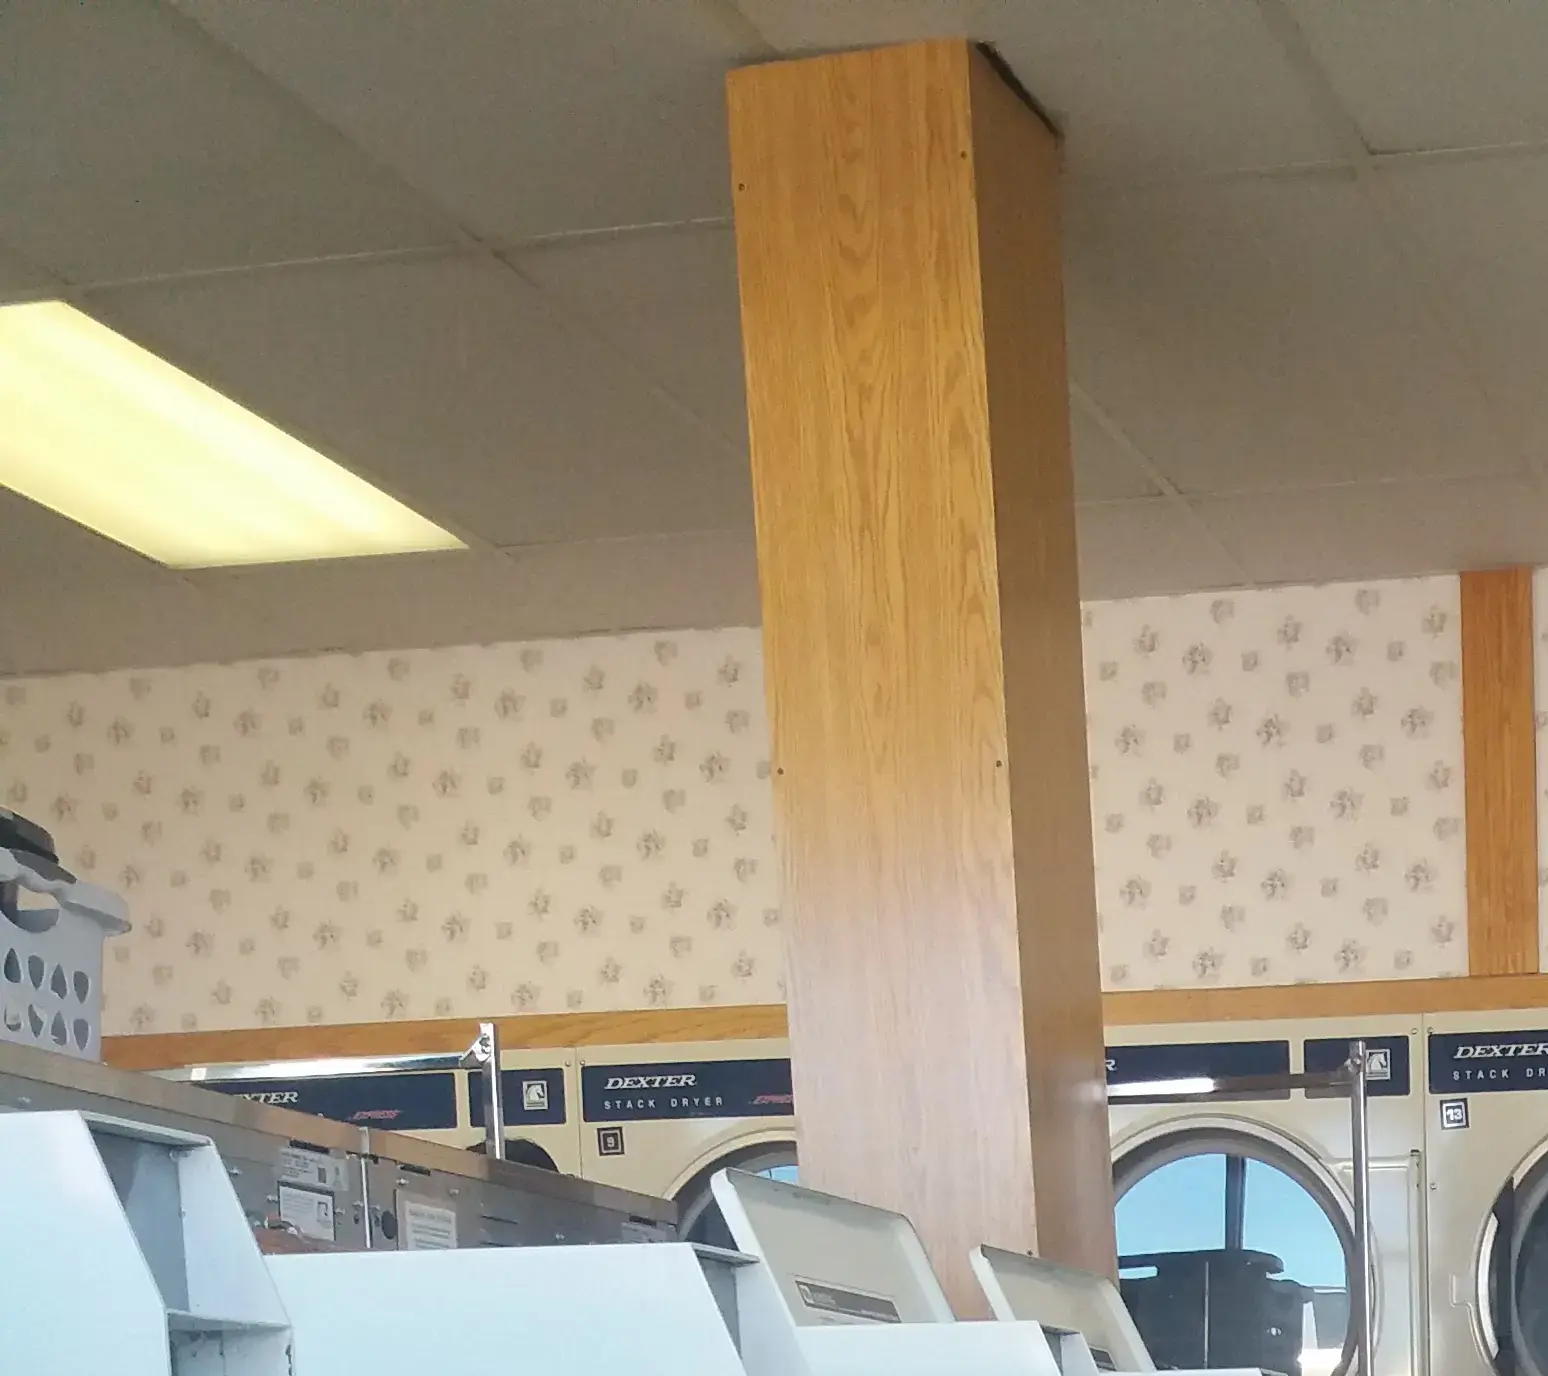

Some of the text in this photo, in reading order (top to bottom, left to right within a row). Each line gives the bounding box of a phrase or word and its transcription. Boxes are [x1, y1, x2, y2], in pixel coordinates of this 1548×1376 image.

[1453, 1067, 1510, 1081] STACK
[604, 1074, 697, 1090] DEXTER
[603, 1096, 723, 1110] STACK DRYER
[1446, 1108, 1463, 1121] 13
[606, 1136, 615, 1148] 9
